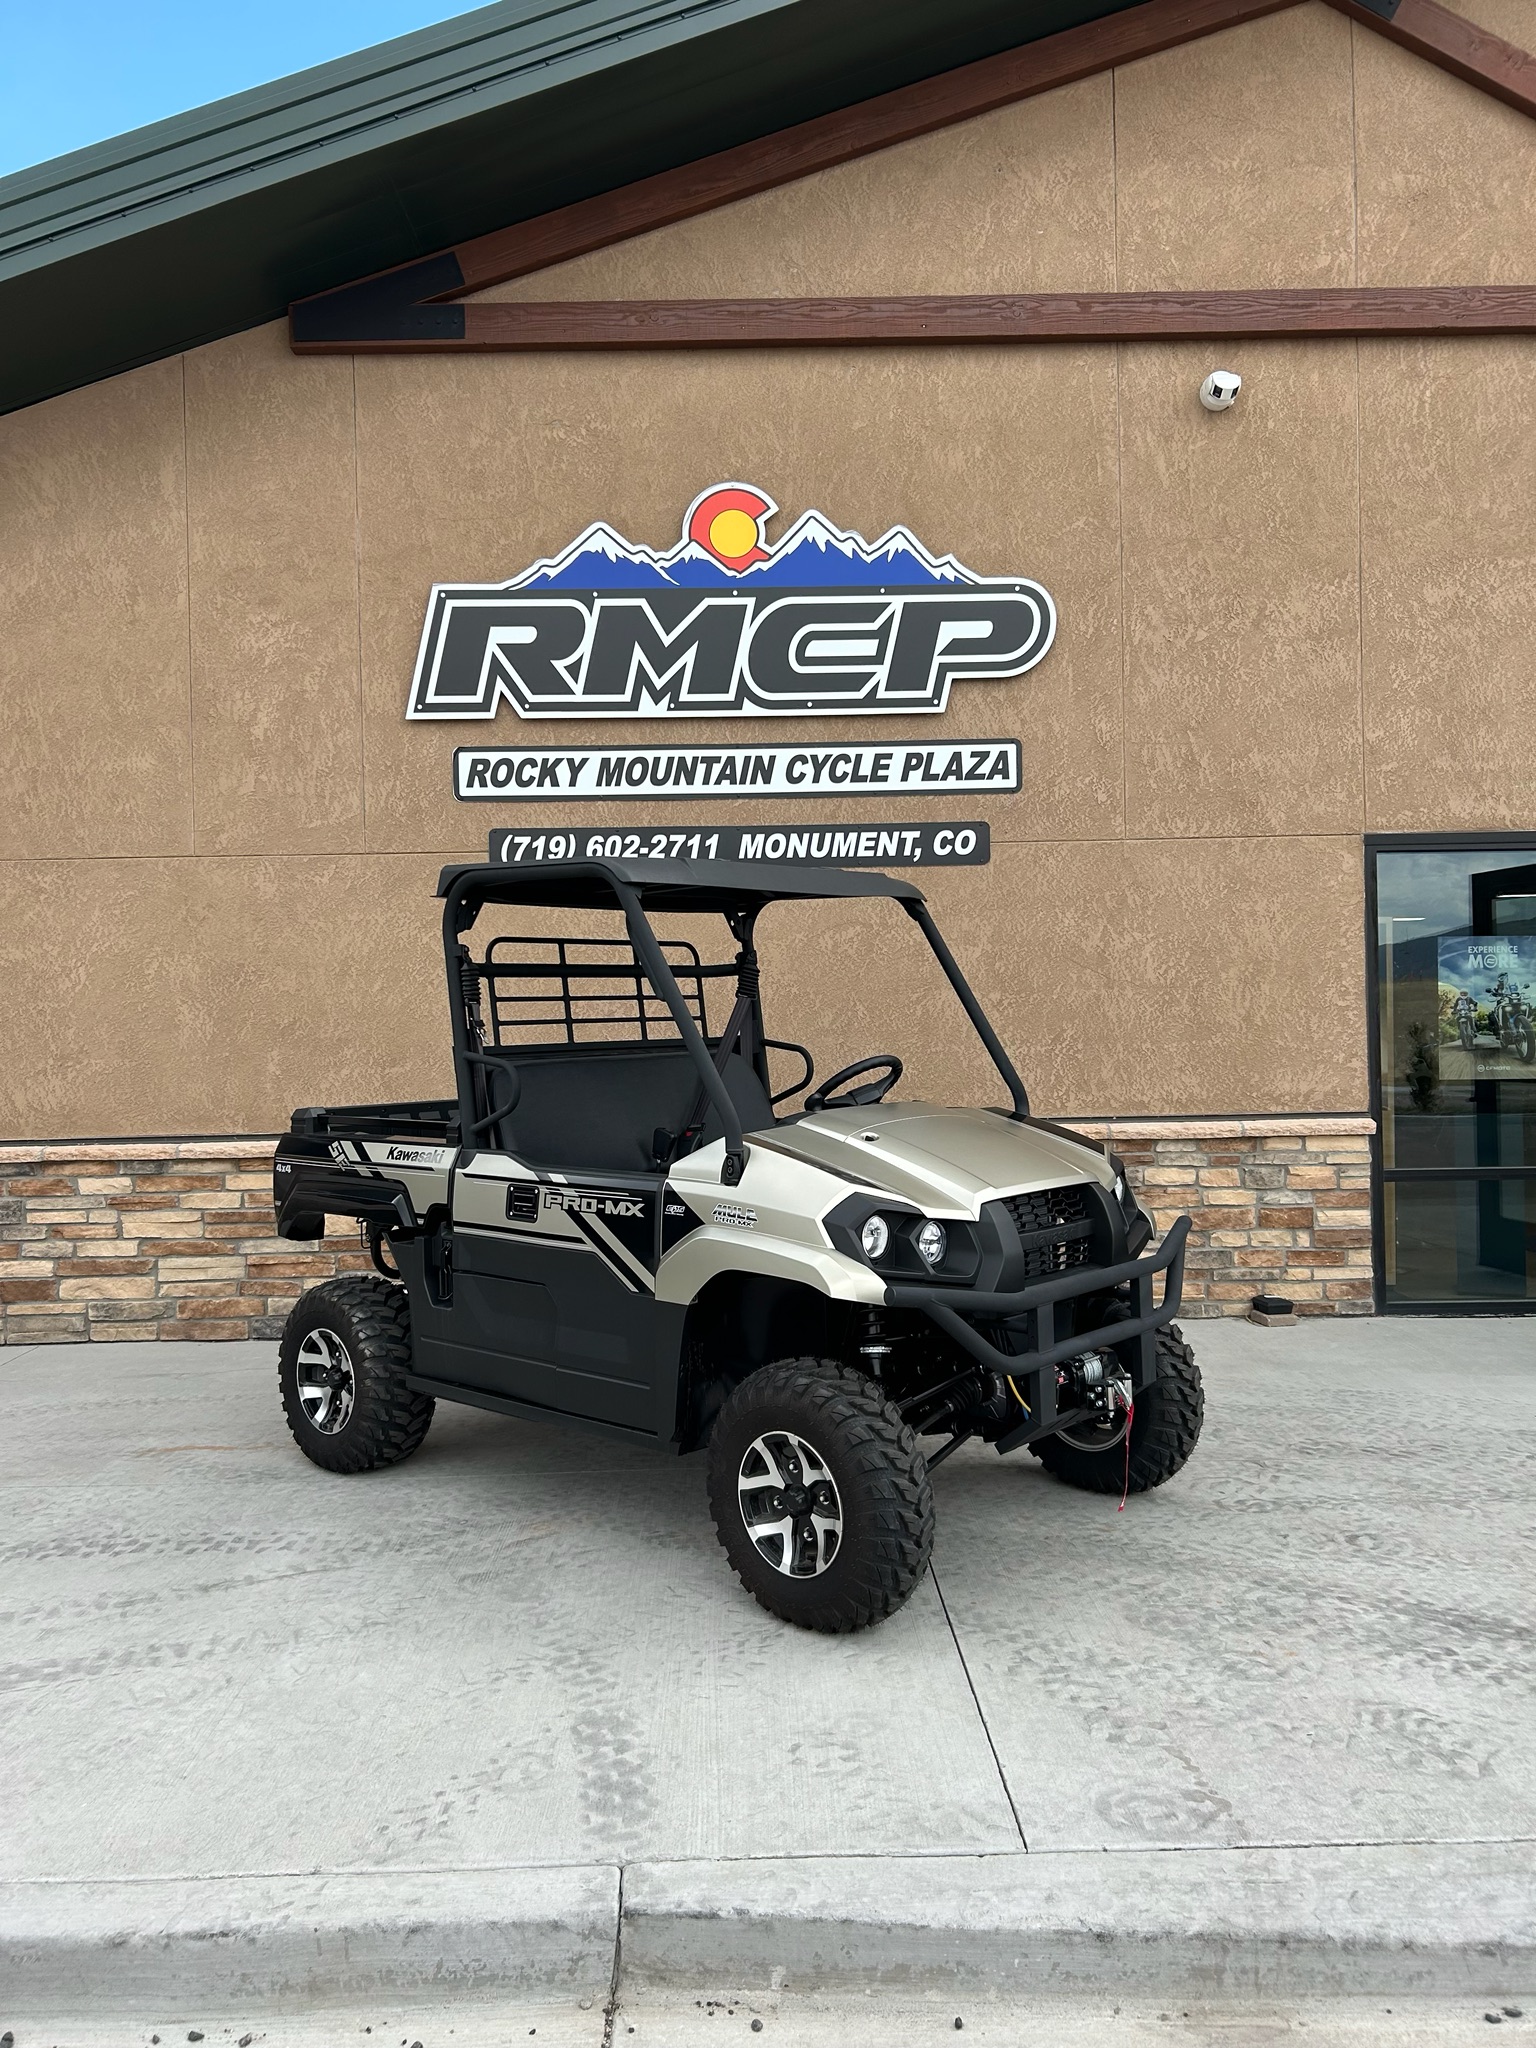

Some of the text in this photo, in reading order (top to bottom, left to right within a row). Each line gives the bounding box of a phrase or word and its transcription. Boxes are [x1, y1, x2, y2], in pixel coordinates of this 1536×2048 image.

[427, 597, 1044, 702] RMCP
[466, 750, 1010, 789] ROCKY MOUNTAIN CYCLE PLAZA
[500, 829, 977, 862] (719) 602-2711 MONUMENT, CO
[1468, 945, 1518, 953] EXPERIENCE
[1467, 954, 1518, 968] MORE
[386, 1146, 445, 1164] Kawasaki
[276, 1163, 292, 1173] 4x4
[544, 1193, 645, 1218] PRO-MX
[712, 1203, 758, 1221] MULE
